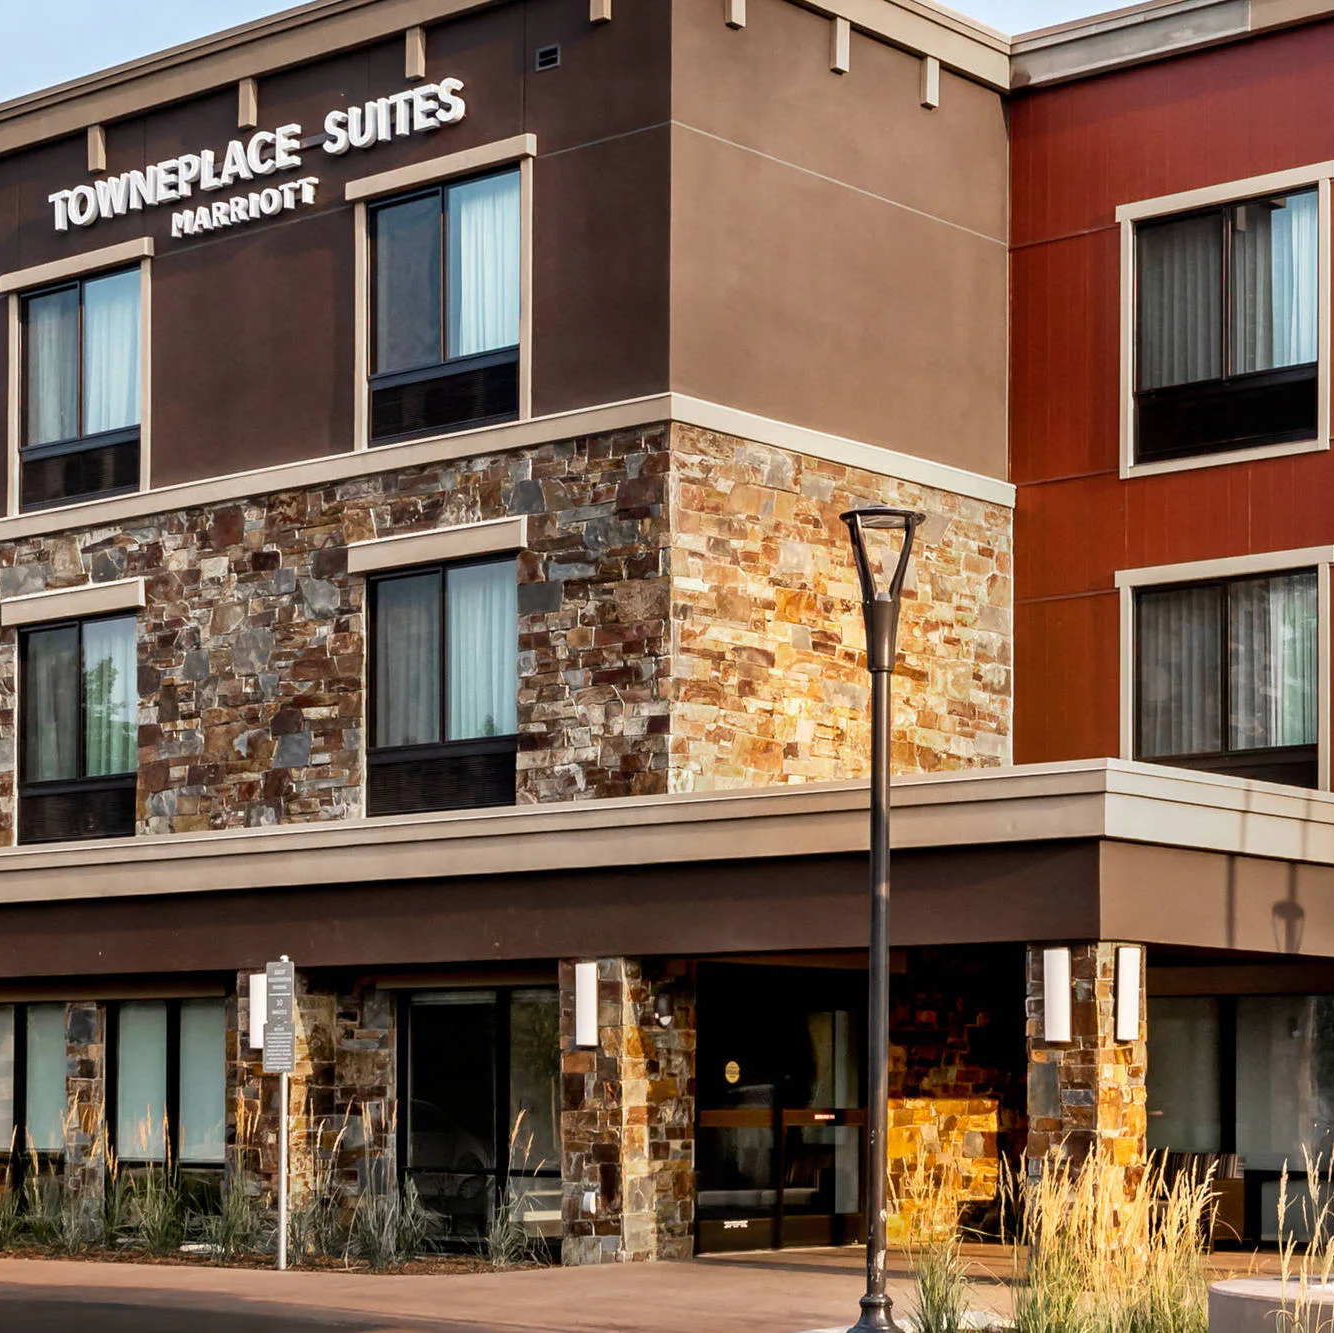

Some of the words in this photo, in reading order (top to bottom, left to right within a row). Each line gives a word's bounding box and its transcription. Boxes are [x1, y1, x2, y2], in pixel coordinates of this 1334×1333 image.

[48, 123, 302, 232] TOWNEPLACE
[323, 77, 466, 155] SUITES
[171, 176, 320, 239] MARRIOTT
